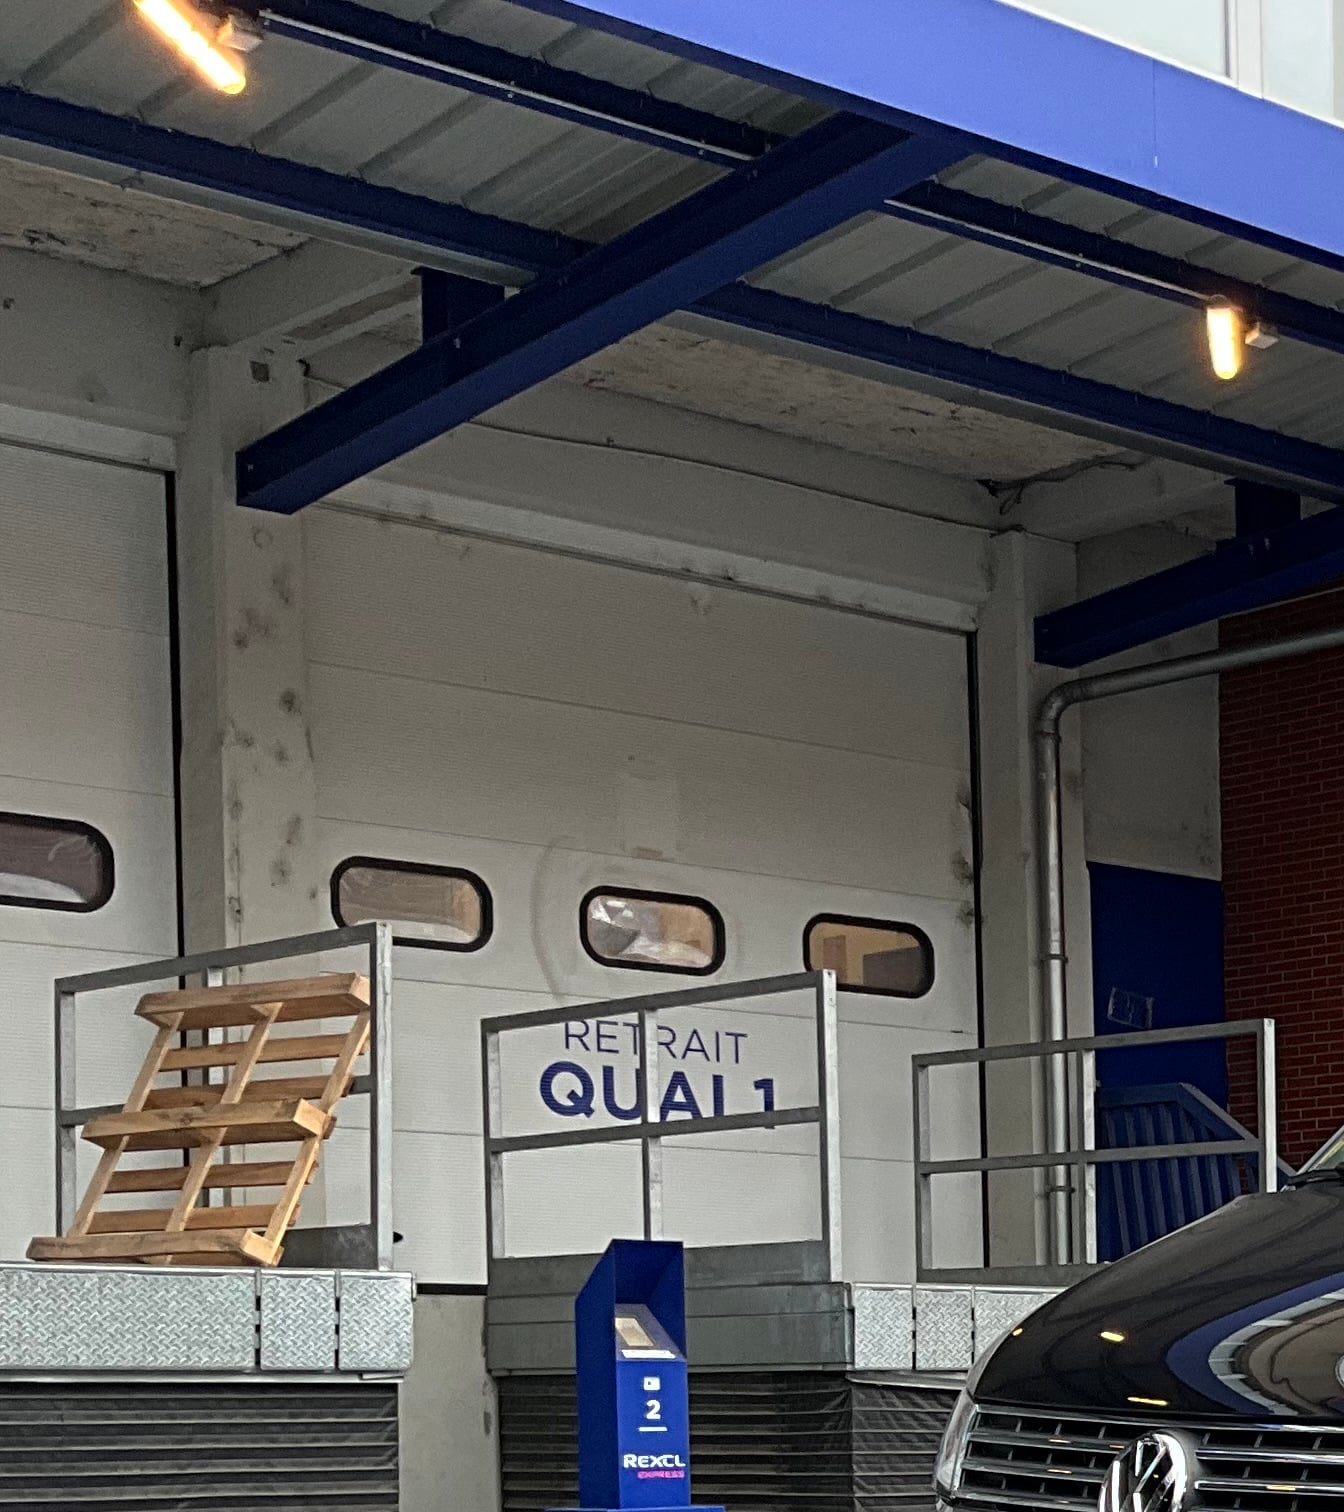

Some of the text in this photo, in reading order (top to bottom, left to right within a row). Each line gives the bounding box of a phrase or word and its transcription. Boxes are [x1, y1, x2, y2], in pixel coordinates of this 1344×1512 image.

[564, 1018, 749, 1064] RETRAIT
[539, 1060, 776, 1130] QUAI 1
[645, 1399, 661, 1420] 2
